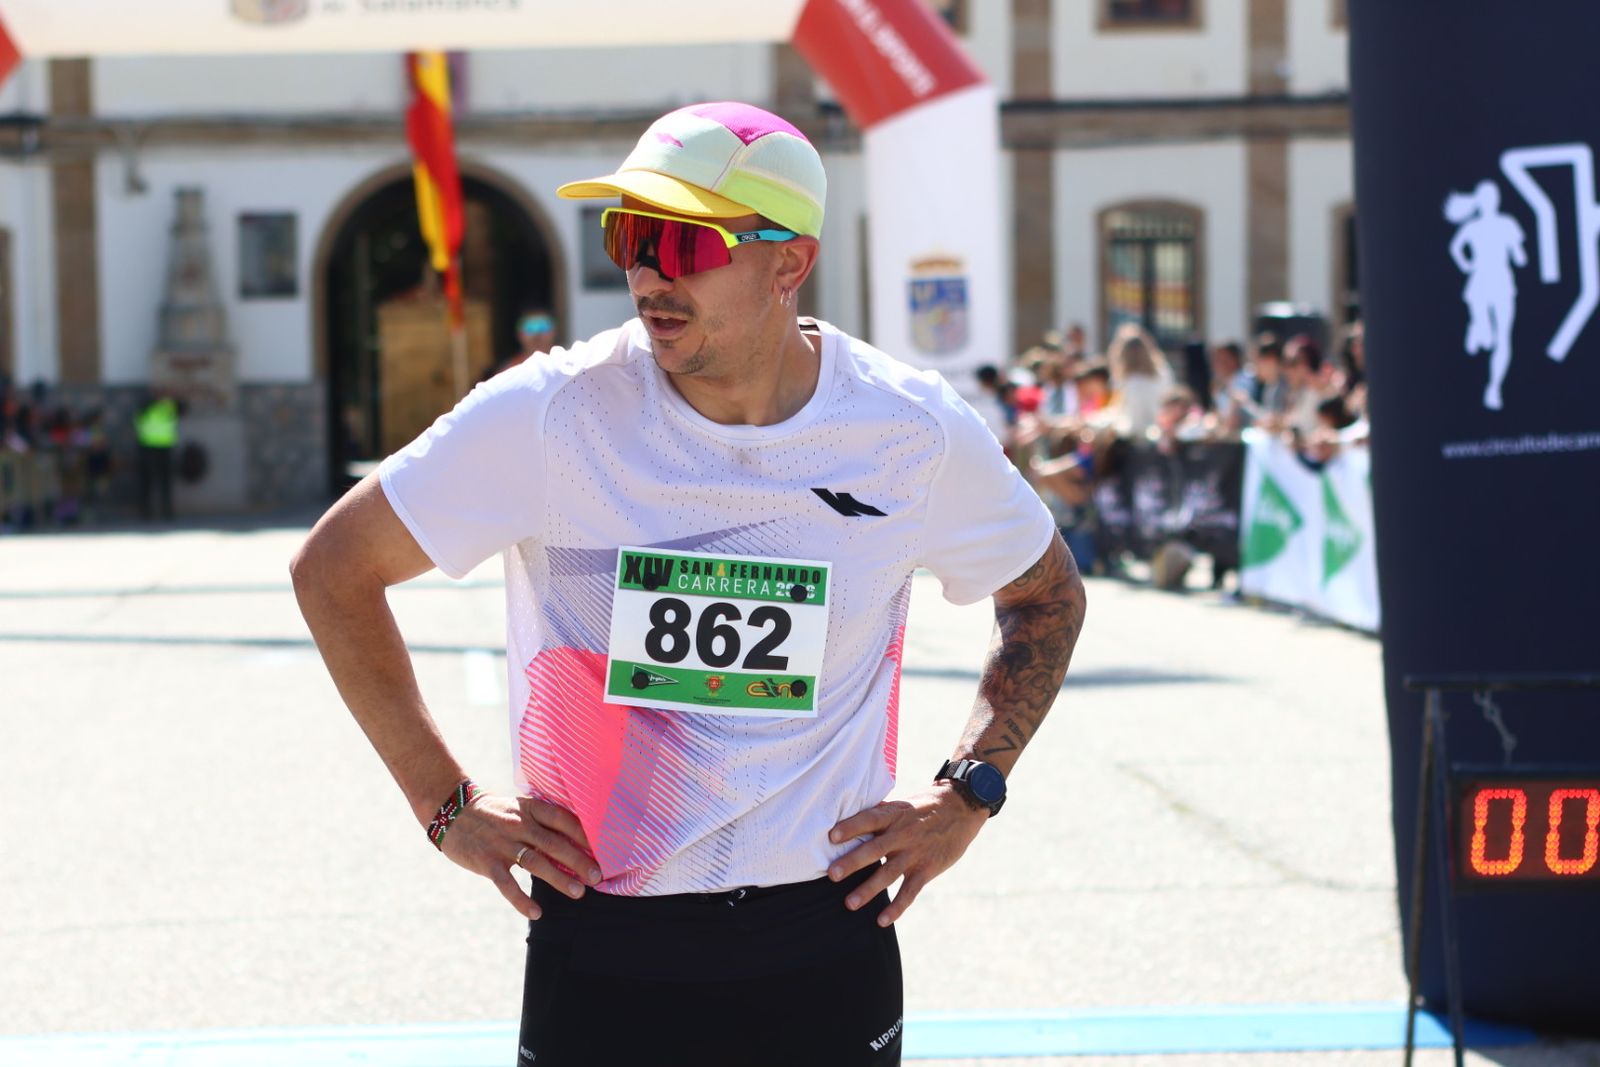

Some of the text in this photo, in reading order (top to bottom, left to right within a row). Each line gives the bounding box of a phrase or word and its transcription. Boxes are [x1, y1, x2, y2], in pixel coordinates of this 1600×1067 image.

[623, 555, 674, 587] XIV
[677, 574, 771, 596] CARRERA
[680, 560, 821, 584] SAN FERNANDO
[644, 597, 792, 671] 862
[1470, 788, 1600, 875] 00
